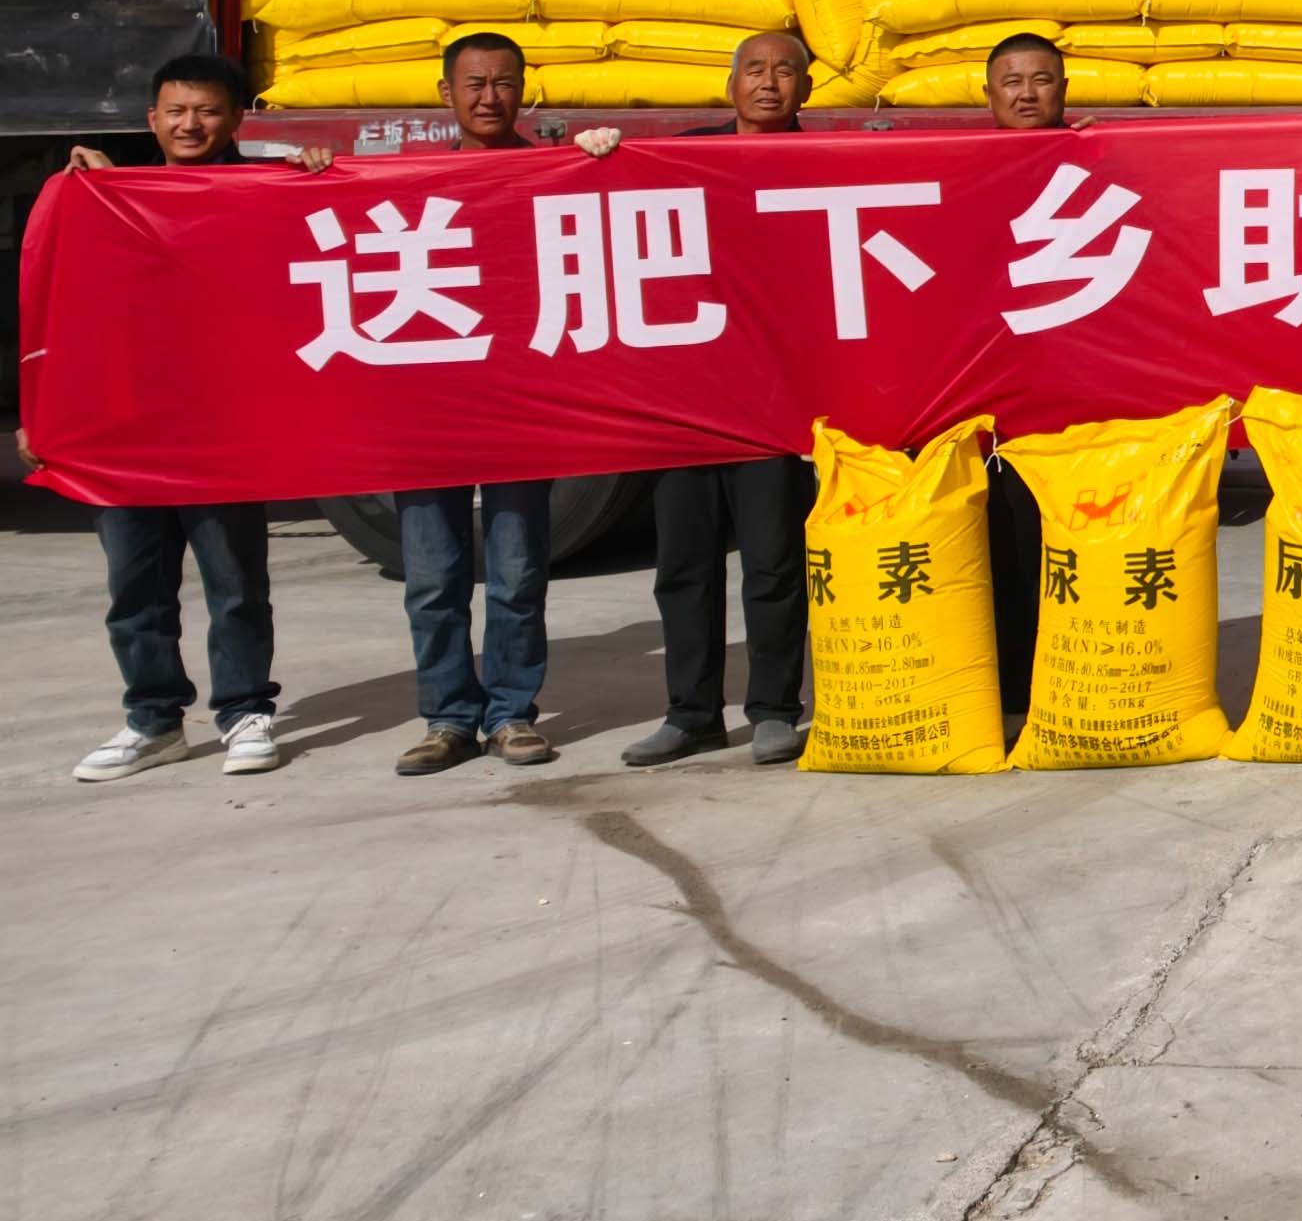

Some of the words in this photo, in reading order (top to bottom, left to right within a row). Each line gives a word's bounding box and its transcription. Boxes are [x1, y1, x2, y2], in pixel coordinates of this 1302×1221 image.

[807, 541, 933, 606] 尿素
[1045, 544, 1178, 610] 尿素
[829, 614, 902, 632] 天然气制造
[1069, 617, 1146, 635] 天然气制造
